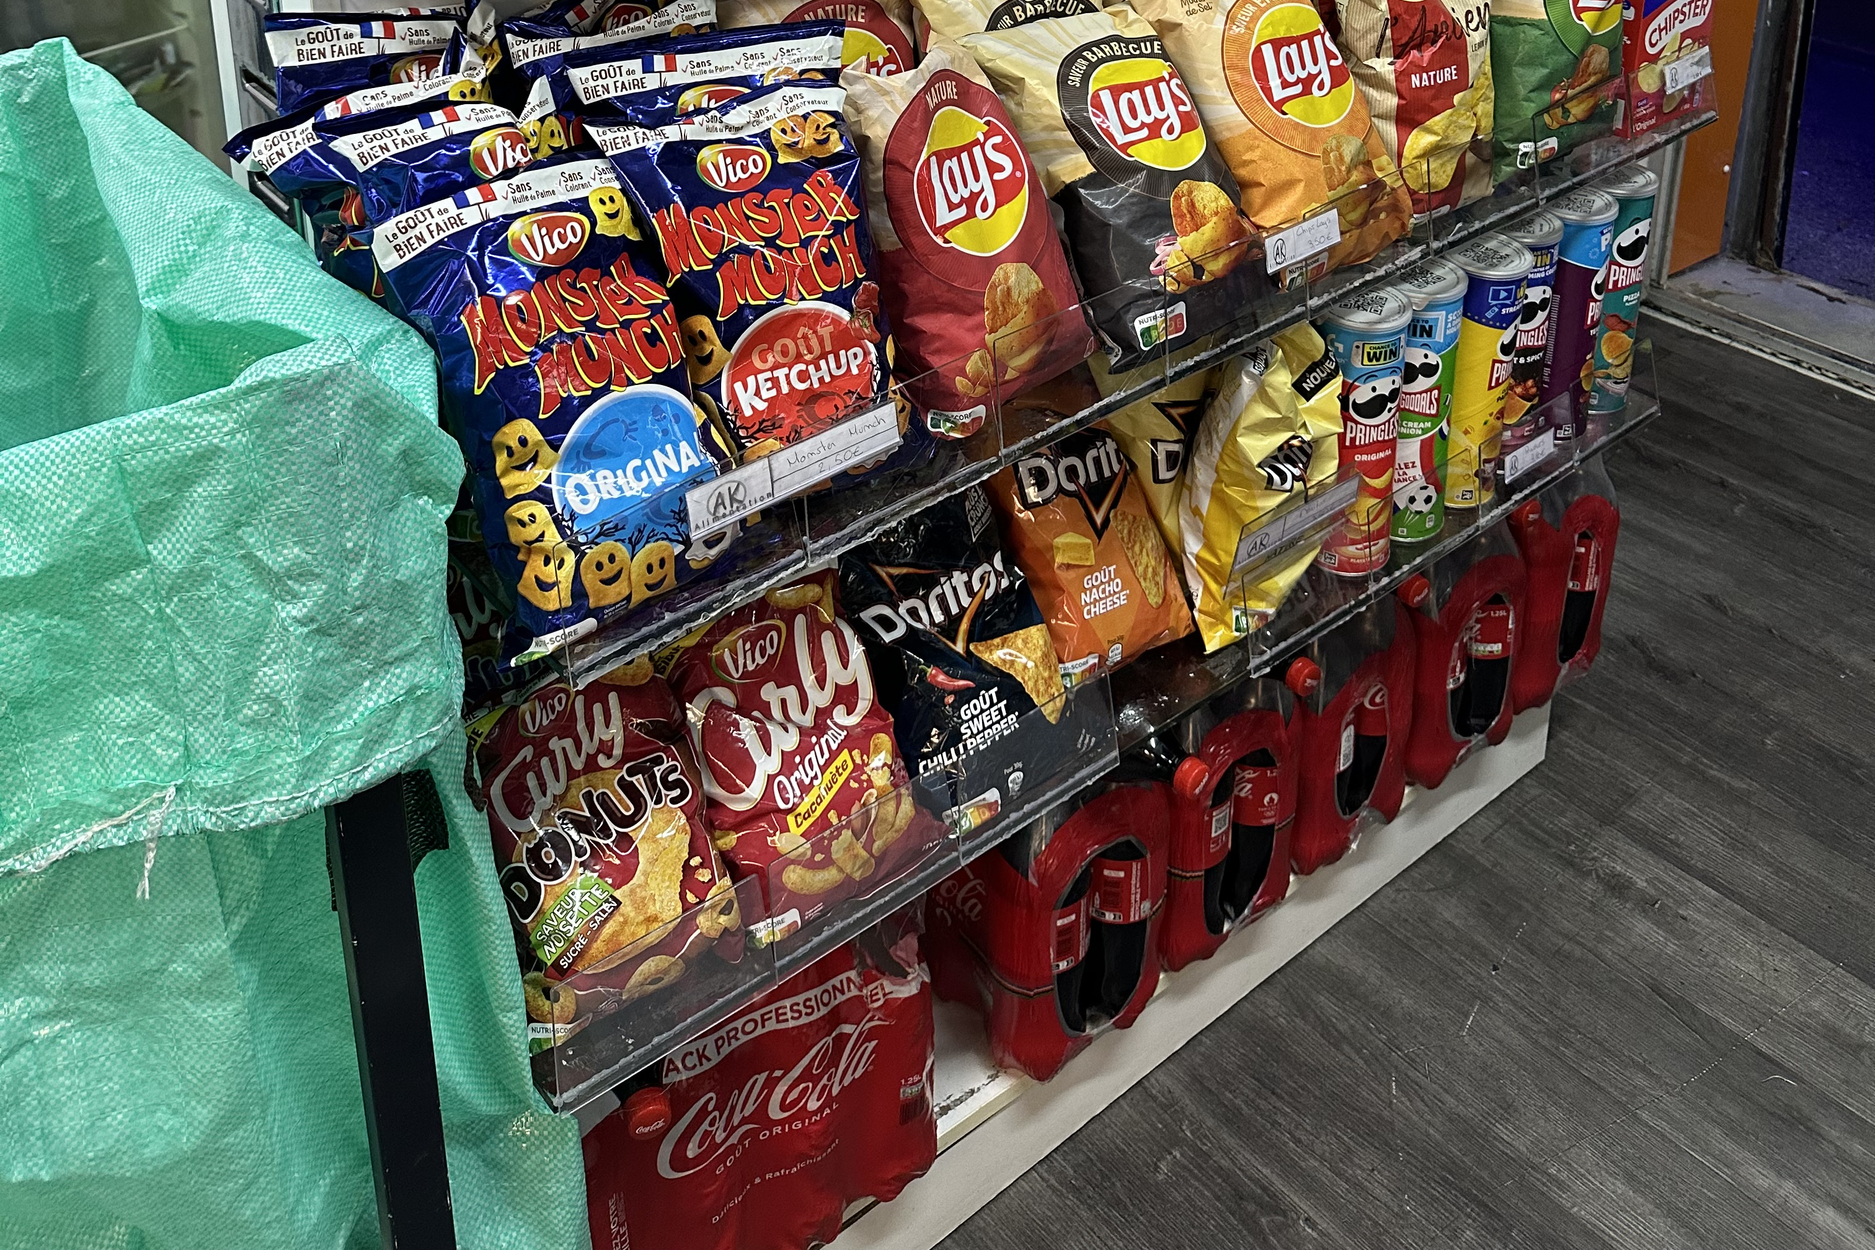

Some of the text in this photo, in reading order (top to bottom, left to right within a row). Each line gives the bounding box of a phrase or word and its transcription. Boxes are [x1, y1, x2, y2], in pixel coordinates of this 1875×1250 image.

[306, 26, 341, 45] GOÛT
[343, 30, 354, 41] de
[590, 65, 625, 80] GOÛT
[625, 68, 636, 76] de
[1263, 26, 1343, 101] Lay's
[1411, 65, 1458, 89] NATURE
[925, 80, 958, 112] NATURE
[1099, 70, 1192, 145] Lay's
[710, 150, 764, 189] Vico
[929, 130, 1013, 228] Lay's
[397, 207, 437, 236] GOÛT
[437, 205, 449, 216] de
[518, 220, 582, 264] Vico
[652, 169, 860, 287] MONSTER
[717, 227, 867, 321] MUNCH
[1623, 292, 1640, 302] PIZZA
[461, 252, 672, 395] MONSTER
[538, 297, 687, 418] MUNCH
[750, 325, 836, 367] GOÛT
[1366, 347, 1398, 363] WIN
[733, 347, 864, 419] KETCHUP
[1345, 418, 1398, 447] PRINGLES
[1354, 449, 1392, 462] ORIGINAL
[1080, 577, 1122, 604] NACHO
[1082, 563, 1117, 589] GOÛT
[860, 552, 1019, 644] Doritos
[1082, 591, 1127, 620] CHEESE
[723, 629, 779, 680] Vico
[523, 690, 568, 736] Vico
[692, 612, 877, 811] Curly
[959, 685, 1000, 723] GOÛT
[959, 701, 1009, 739] SWEET
[490, 688, 625, 834] Curly
[773, 723, 848, 810] Original
[792, 757, 850, 832] Cacahuète
[537, 888, 582, 942] SAVEUR
[543, 884, 610, 960] NOISETTE
[559, 933, 589, 969] SUCRÉ
[664, 1044, 715, 1080] ACK
[900, 1075, 922, 1086] 1.25L
[657, 1020, 896, 1180] Coca-Cola
[635, 1119, 666, 1135] Coca-Cola
[715, 1101, 840, 1177] GOÛT ORIGINAL
